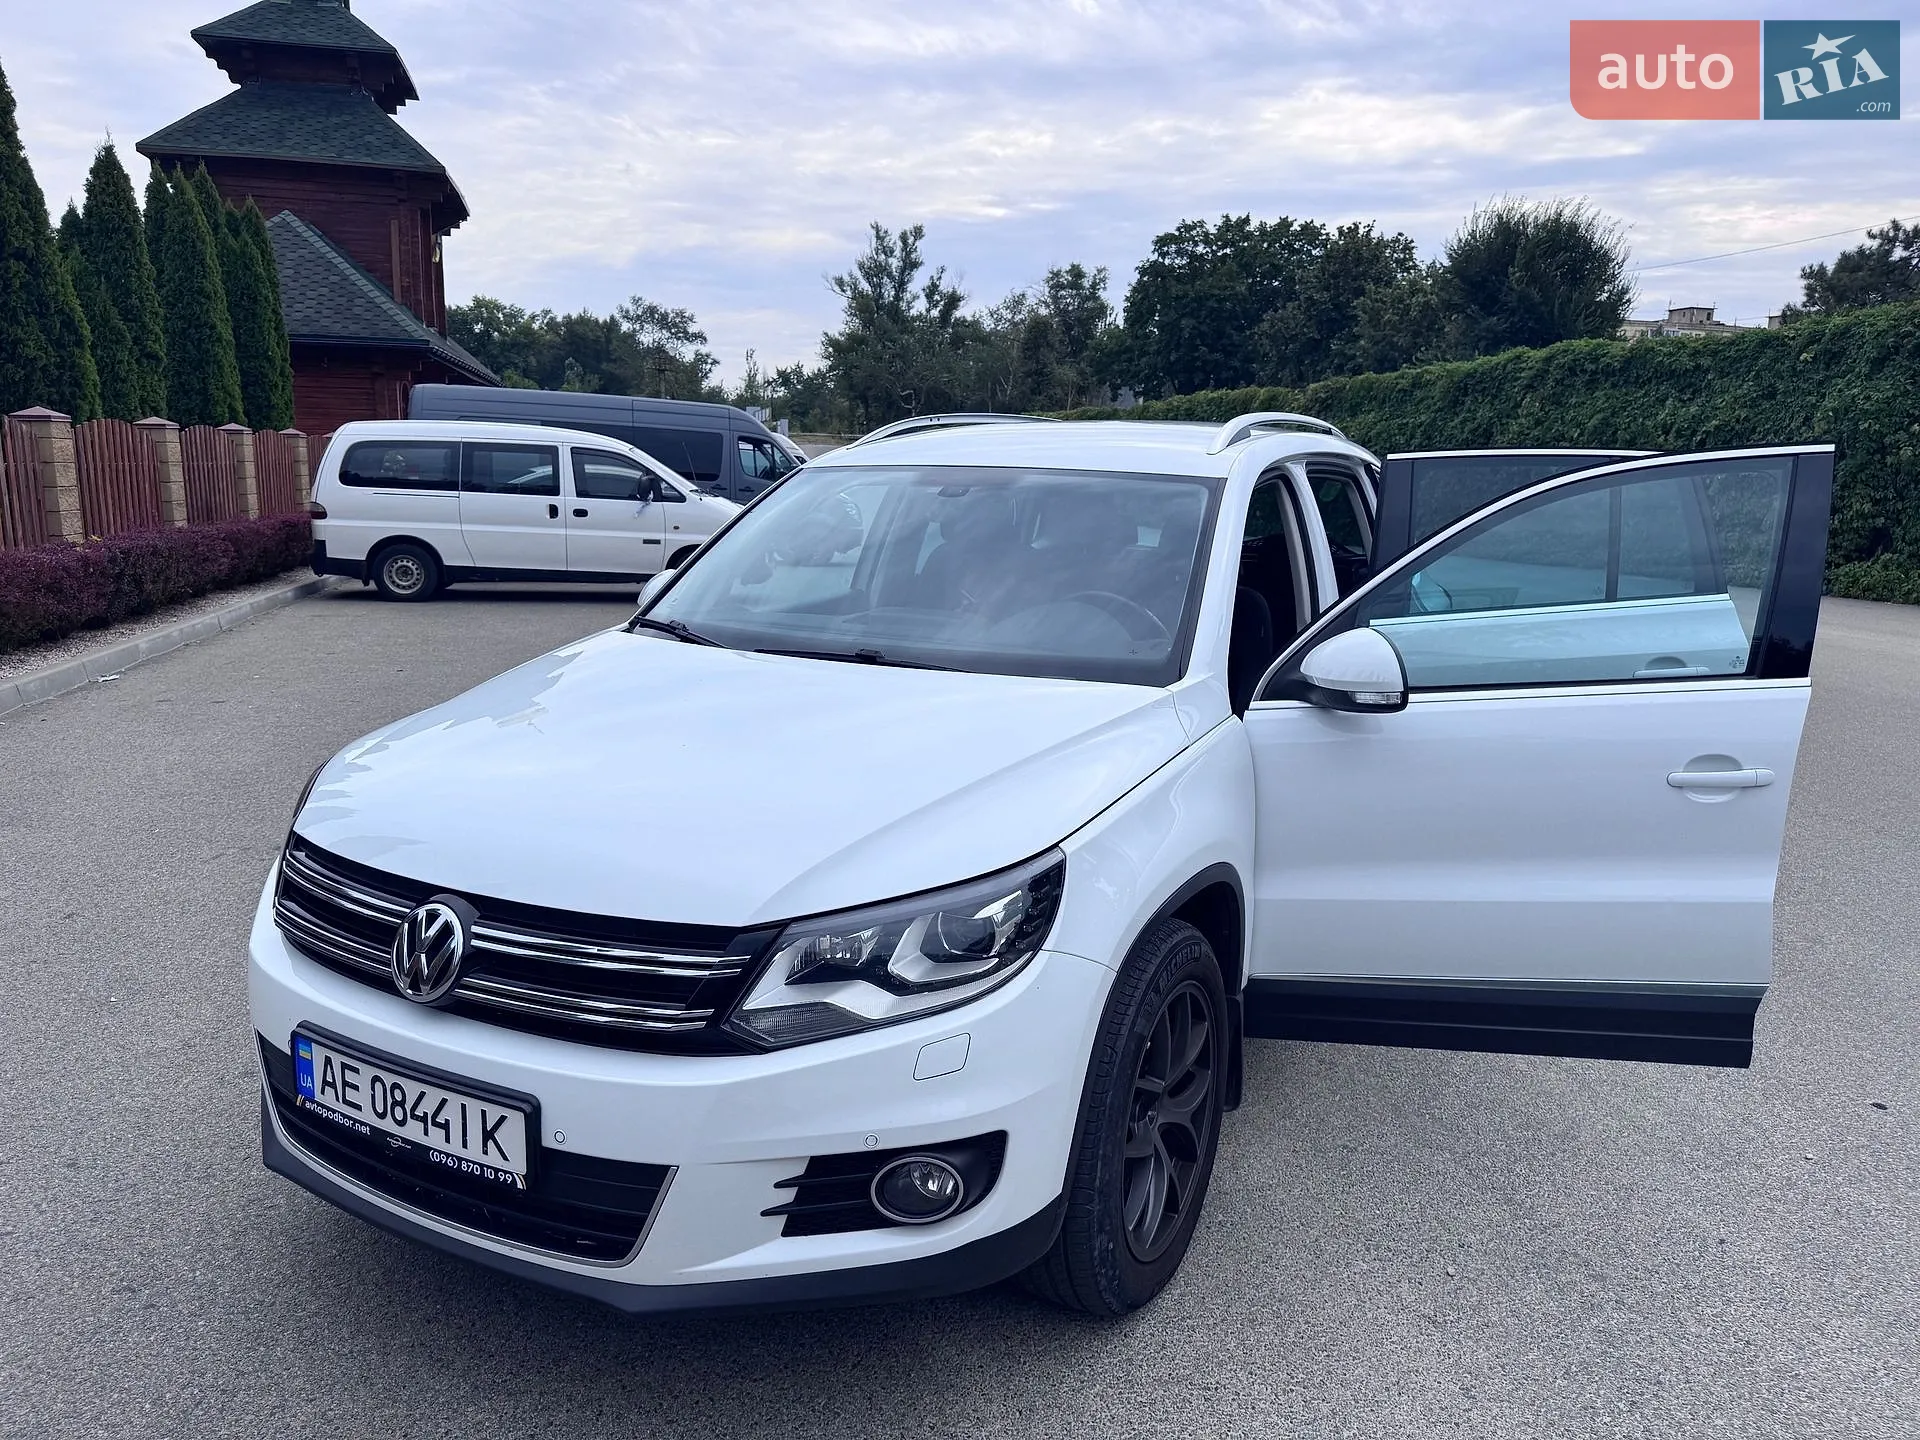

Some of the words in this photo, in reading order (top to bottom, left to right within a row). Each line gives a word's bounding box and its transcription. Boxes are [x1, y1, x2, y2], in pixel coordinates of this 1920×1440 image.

[300, 1072, 313, 1091] UA
[305, 1100, 371, 1136] avtopodbor.net
[429, 1150, 458, 1170] (096)
[461, 1160, 481, 1176] 870
[483, 1167, 495, 1181] 10
[498, 1171, 513, 1185] 99
